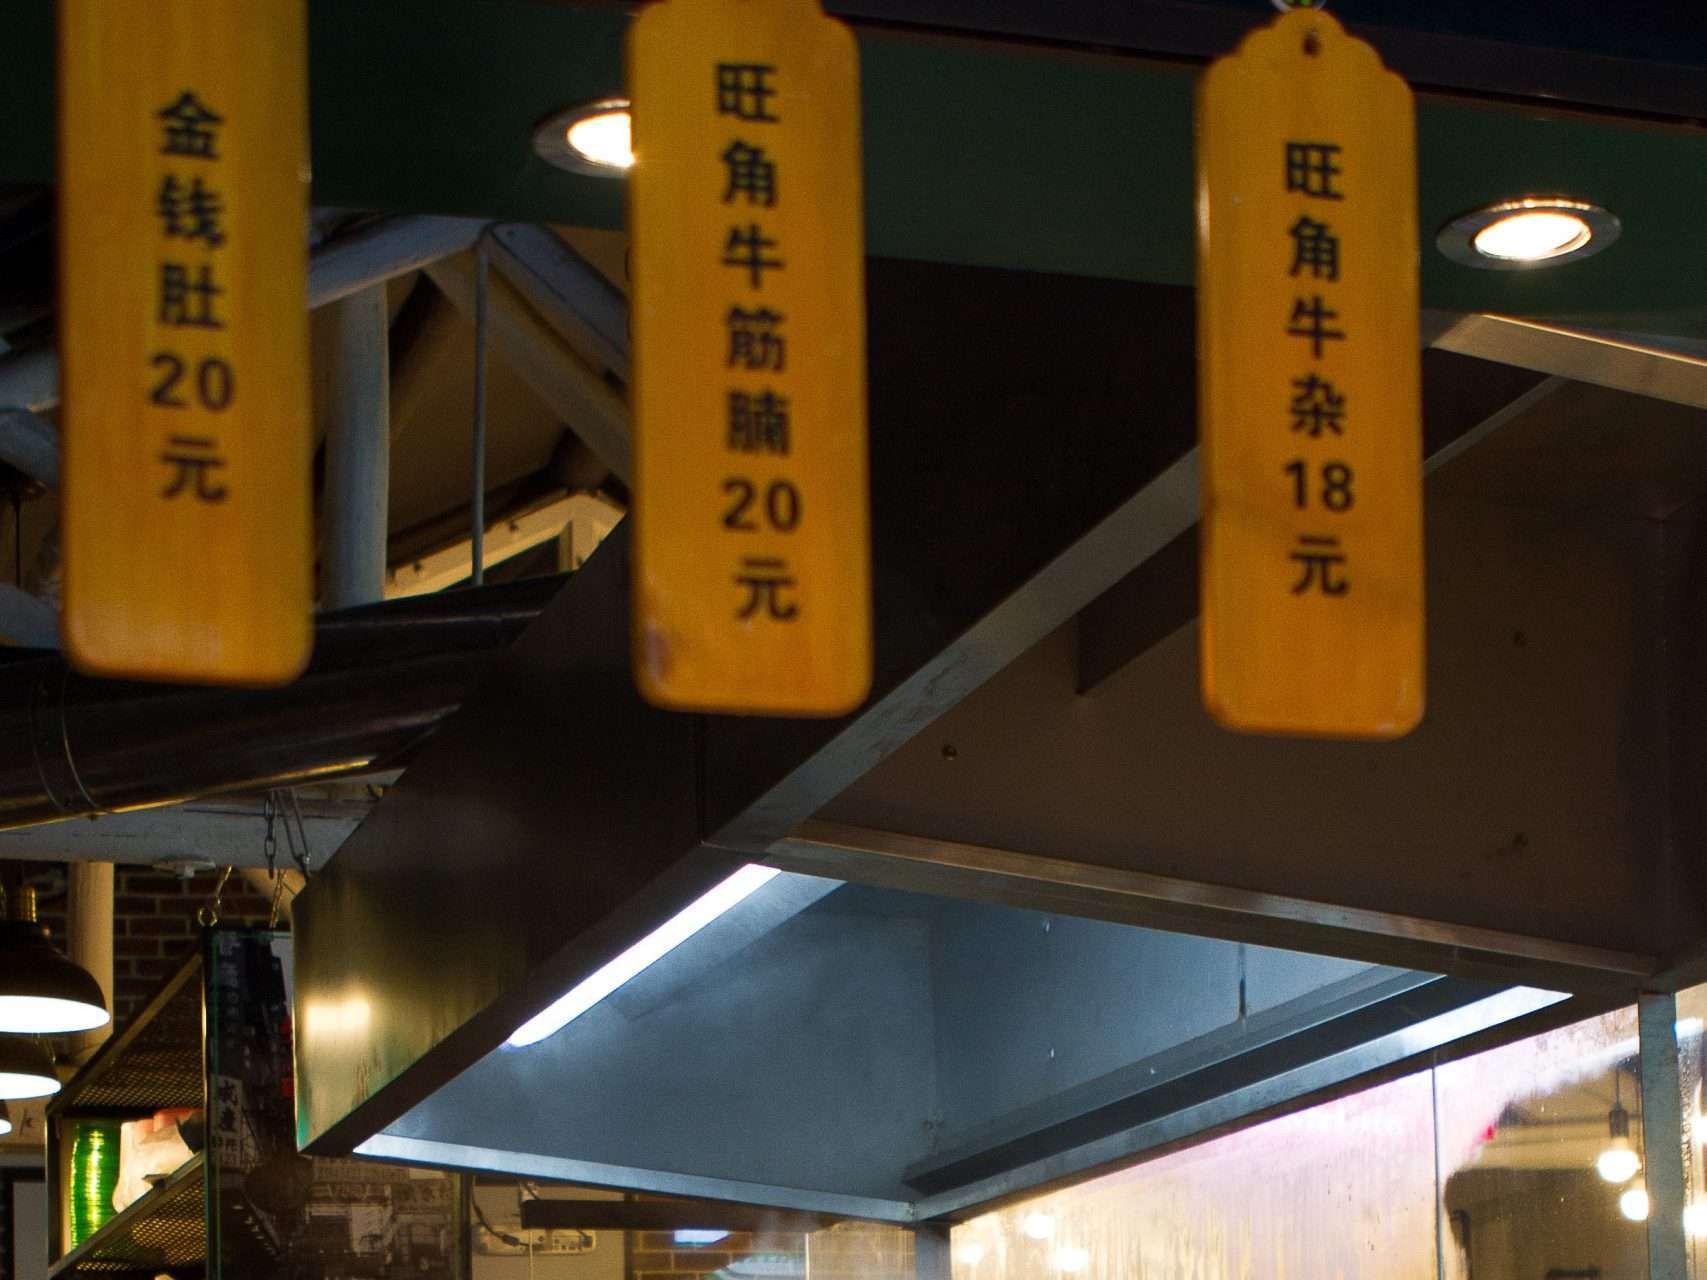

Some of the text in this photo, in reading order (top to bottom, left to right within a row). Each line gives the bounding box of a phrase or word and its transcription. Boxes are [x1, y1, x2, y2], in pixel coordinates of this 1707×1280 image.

[148, 89, 234, 504] 金钱肚20元
[713, 60, 801, 623] 旺角牛筋腩20元
[1283, 139, 1355, 598] 旺角牛杂18元
